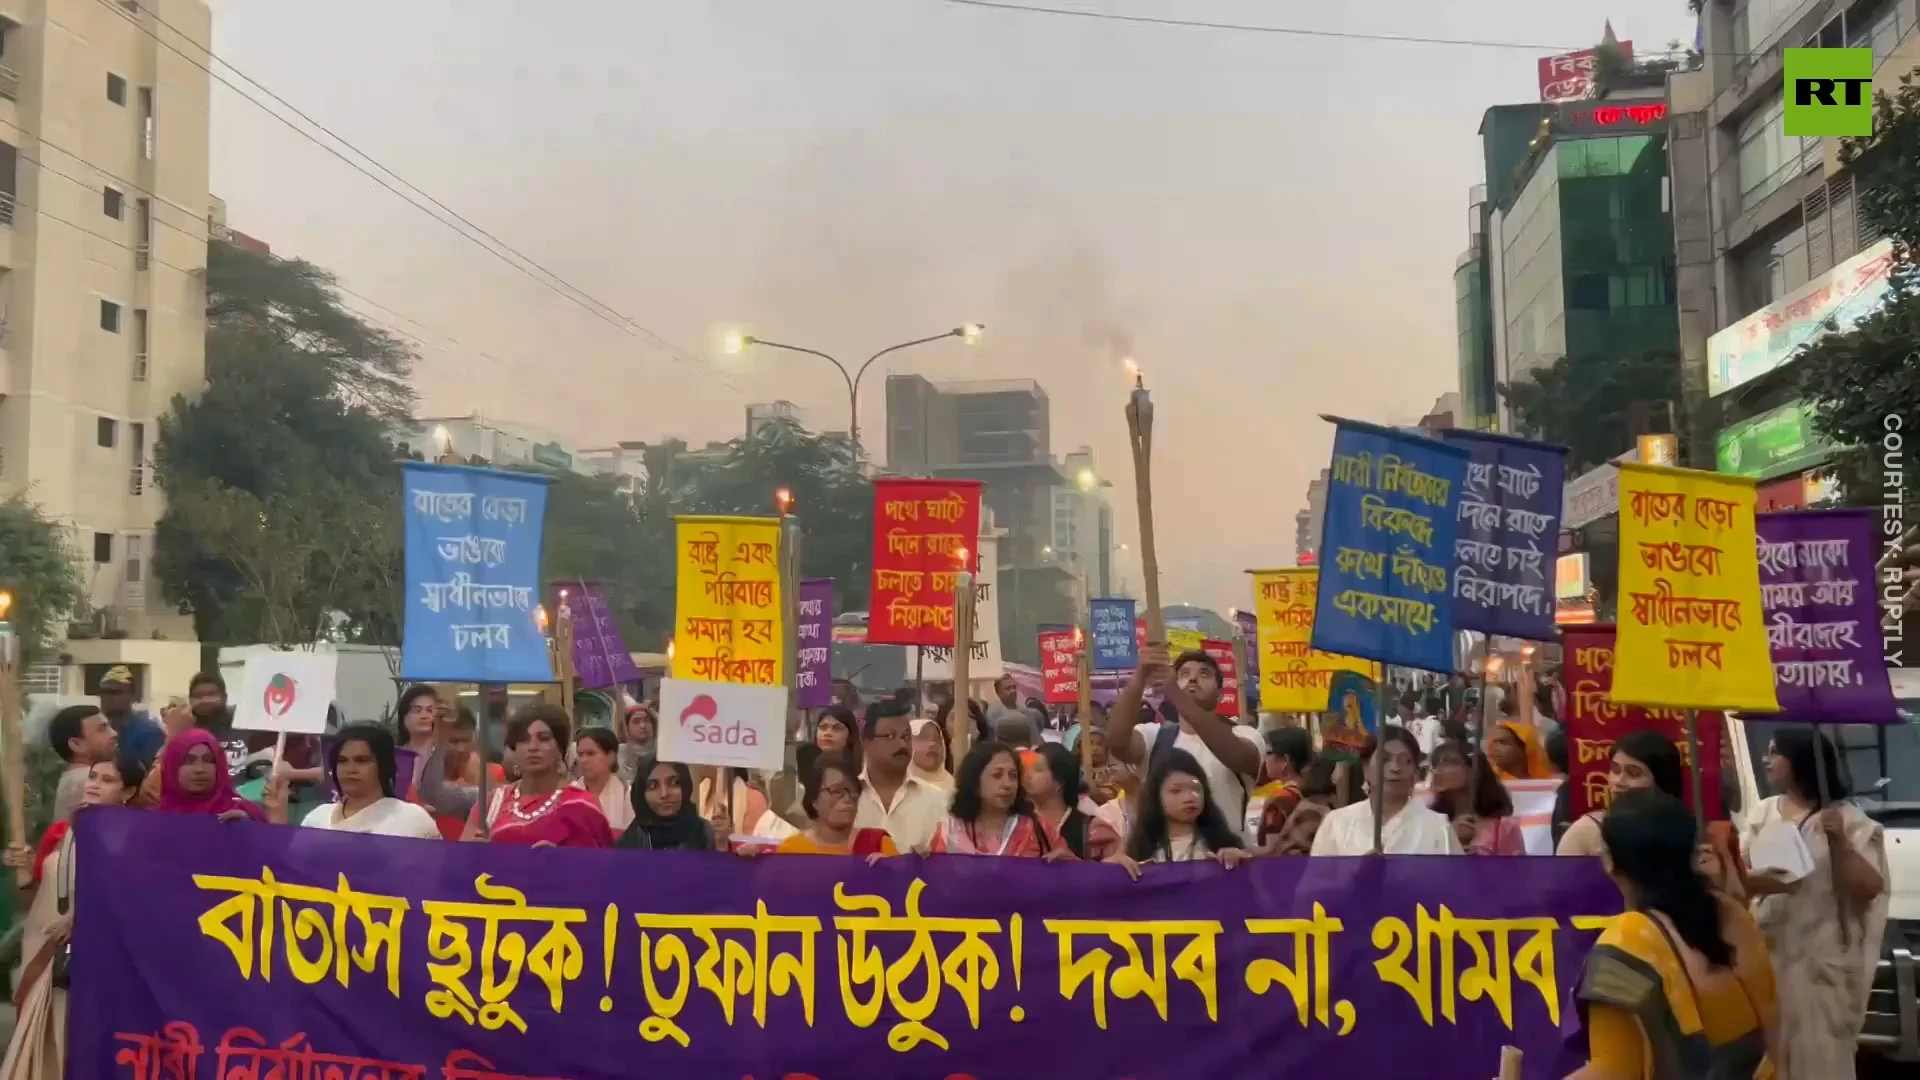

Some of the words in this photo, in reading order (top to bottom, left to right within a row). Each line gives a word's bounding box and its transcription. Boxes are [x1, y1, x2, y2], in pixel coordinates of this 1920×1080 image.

[1464, 463, 1493, 492] থে
[1497, 463, 1542, 499] ঘাটে
[885, 500, 921, 522] পথে
[925, 491, 969, 523] ঘাটে
[1628, 489, 1687, 527] রাতের
[1695, 497, 1741, 535] বেড়া
[1505, 508, 1554, 540] রাতে
[732, 543, 777, 567] এবং
[886, 528, 922, 558] দিনে
[1507, 539, 1545, 579] চাই
[1637, 541, 1724, 576] ভাঙবো
[705, 571, 773, 609] পরিবারে
[874, 569, 924, 598] চলতে
[1629, 577, 1742, 631] স্বাধীনভাবে
[451, 624, 511, 651] চলব
[685, 616, 733, 643] সমান
[740, 619, 775, 644] হব
[692, 647, 776, 686] অধিকারে
[1664, 639, 1724, 671] চলব
[692, 720, 759, 747] sada
[192, 866, 411, 998] বাতাস
[634, 898, 822, 1047] তুফান
[1043, 918, 1222, 1029] দমব
[1244, 901, 1356, 1036] না,
[1371, 902, 1560, 1030] থামব
